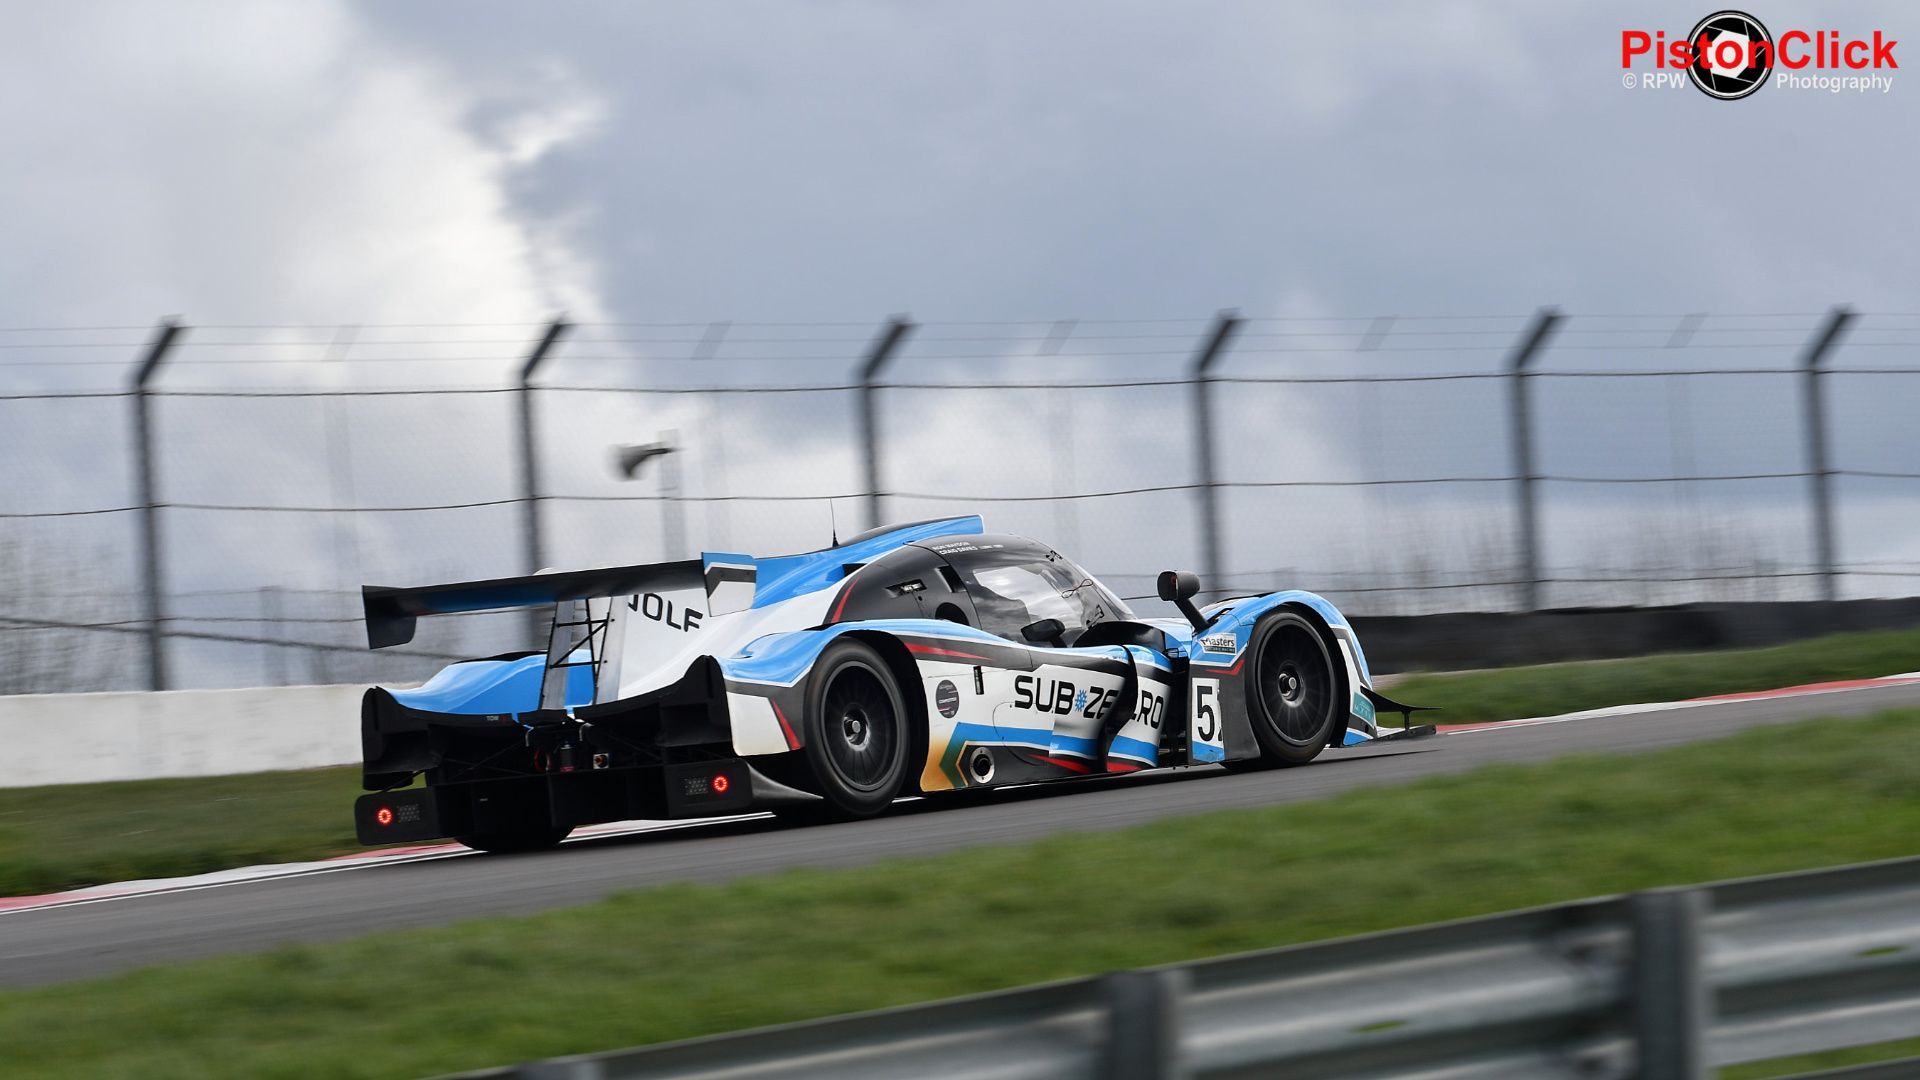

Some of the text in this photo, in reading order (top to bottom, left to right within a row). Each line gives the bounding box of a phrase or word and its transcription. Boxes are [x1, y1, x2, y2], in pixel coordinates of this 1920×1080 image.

[1200, 637, 1235, 647] Masters
[1014, 674, 1076, 716] SUB
[1196, 685, 1223, 743] 5
